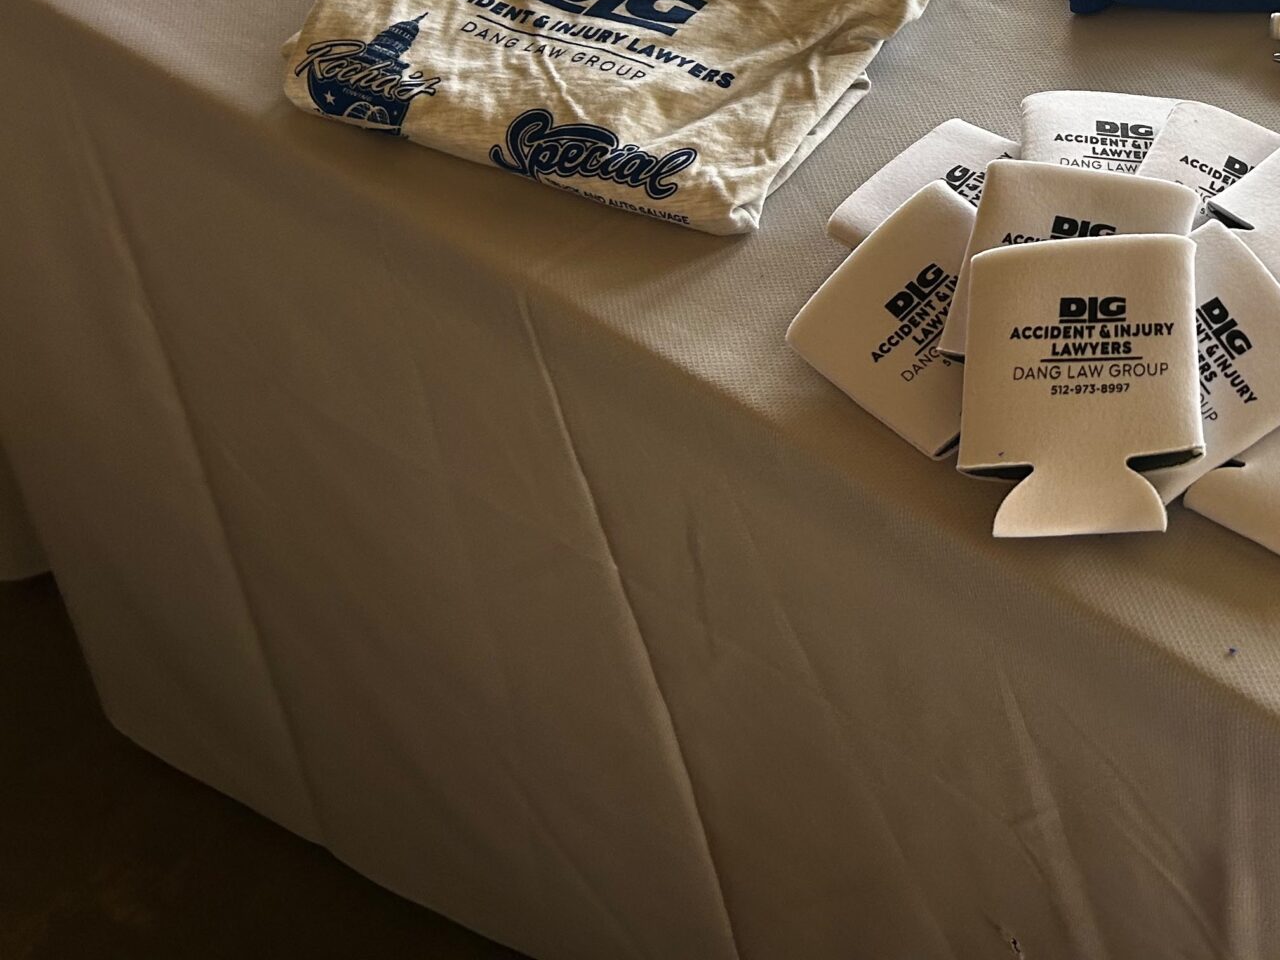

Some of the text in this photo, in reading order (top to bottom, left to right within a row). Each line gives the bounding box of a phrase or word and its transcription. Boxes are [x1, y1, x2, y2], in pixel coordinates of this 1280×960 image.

[460, 21, 647, 81] DANG LAW GROUP
[533, 14, 550, 29] &
[549, 20, 629, 45] INJURY
[625, 38, 736, 89] LAWYERS
[1054, 133, 1128, 148] ACCIDENT
[1131, 140, 1141, 149] &
[1096, 120, 1153, 139] DLG
[489, 108, 698, 200] Special
[1060, 158, 1138, 173] DANG LAW
[1091, 146, 1147, 159] LAWYE
[609, 198, 638, 212] AUTO
[638, 206, 690, 224] SALVAGE
[1051, 215, 1116, 240] DLG
[884, 263, 950, 322] DLG
[1059, 297, 1126, 323] DLG
[871, 291, 949, 363] ACCIDENT &
[1010, 322, 1174, 339] ACCIDENT & INJURY
[1196, 296, 1252, 360] DLG
[1051, 341, 1132, 356] LAWYERS
[901, 346, 940, 382] DANG
[1013, 363, 1169, 380] DANG LAW GROUP
[1205, 343, 1219, 358] &
[1213, 353, 1258, 405] INJURY
[1051, 383, 1130, 395] 512-973-8997
